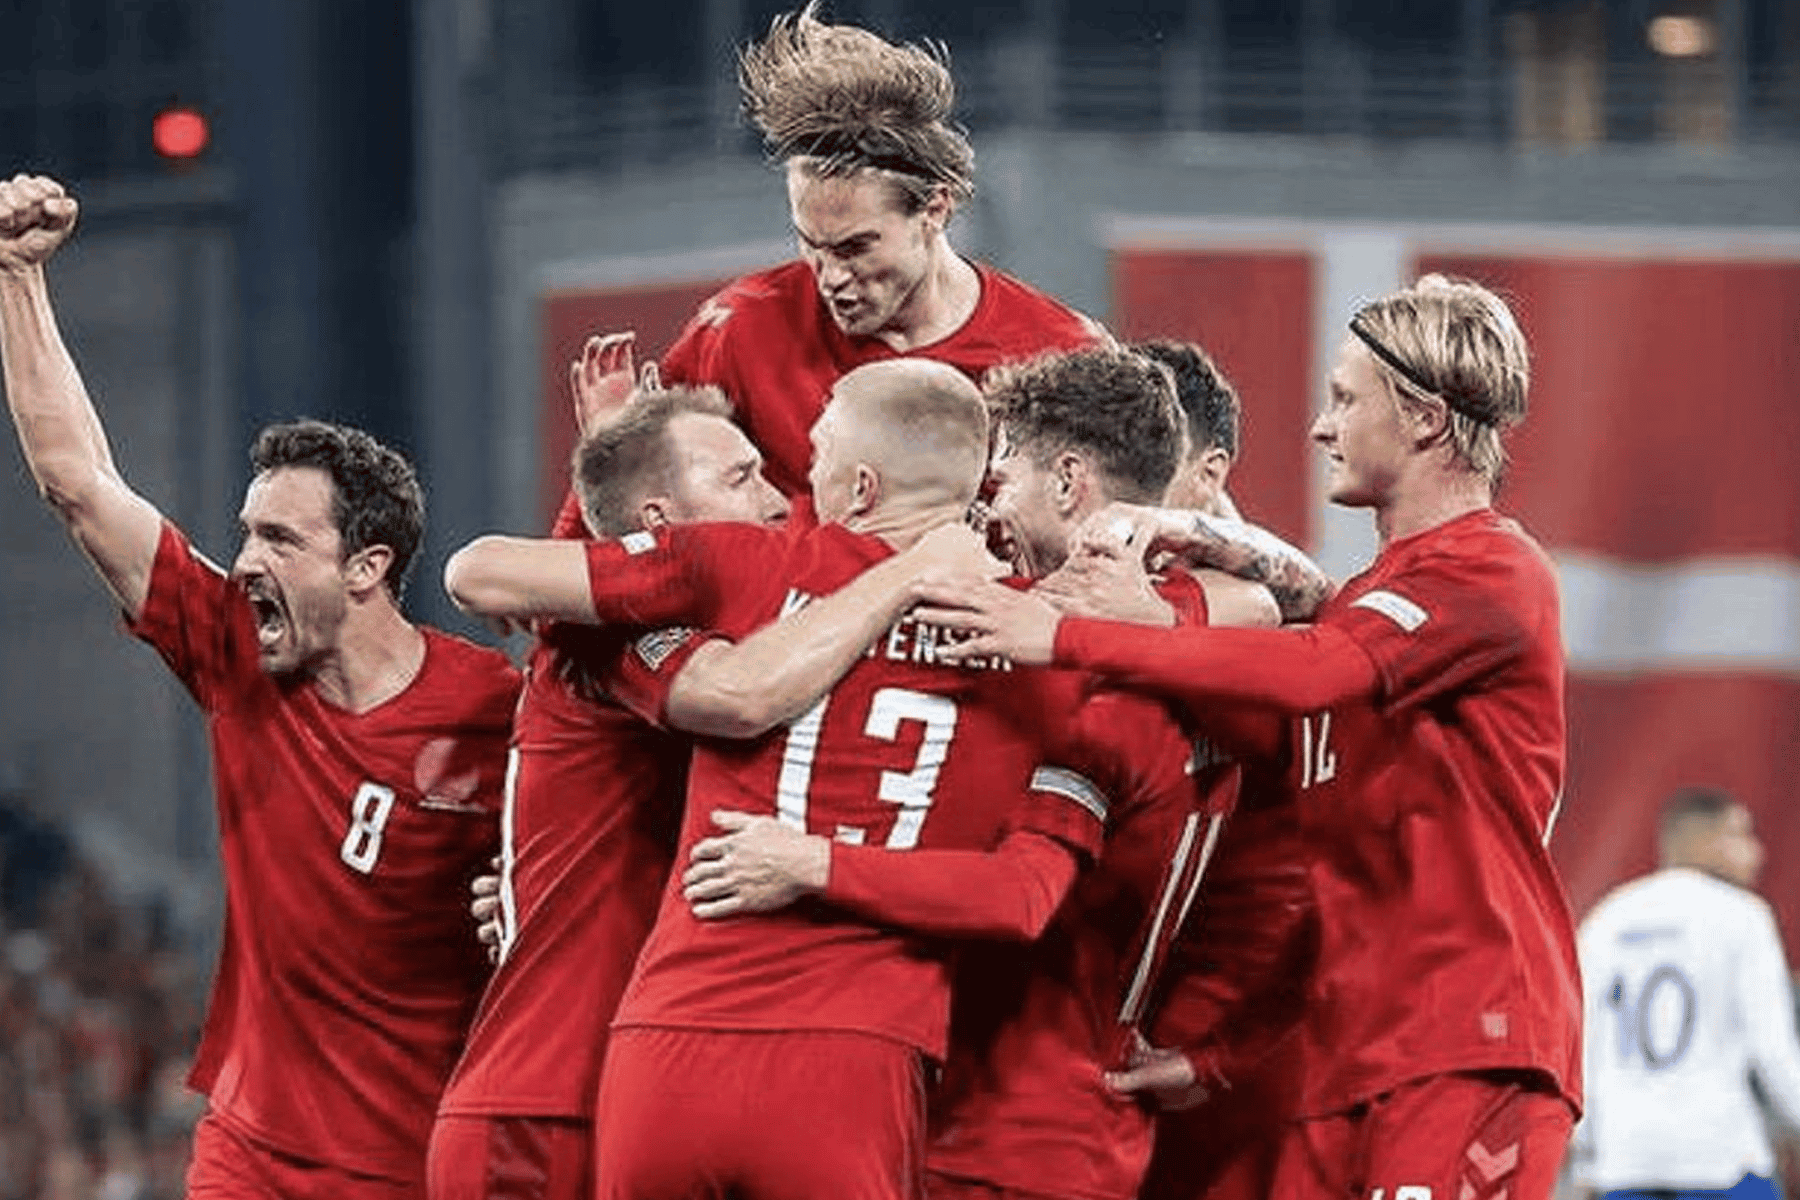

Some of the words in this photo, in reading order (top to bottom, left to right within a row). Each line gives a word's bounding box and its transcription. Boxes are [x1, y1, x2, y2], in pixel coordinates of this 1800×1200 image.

[776, 688, 958, 850] 13
[340, 780, 396, 874] 8
[1603, 962, 1698, 1071] 10
